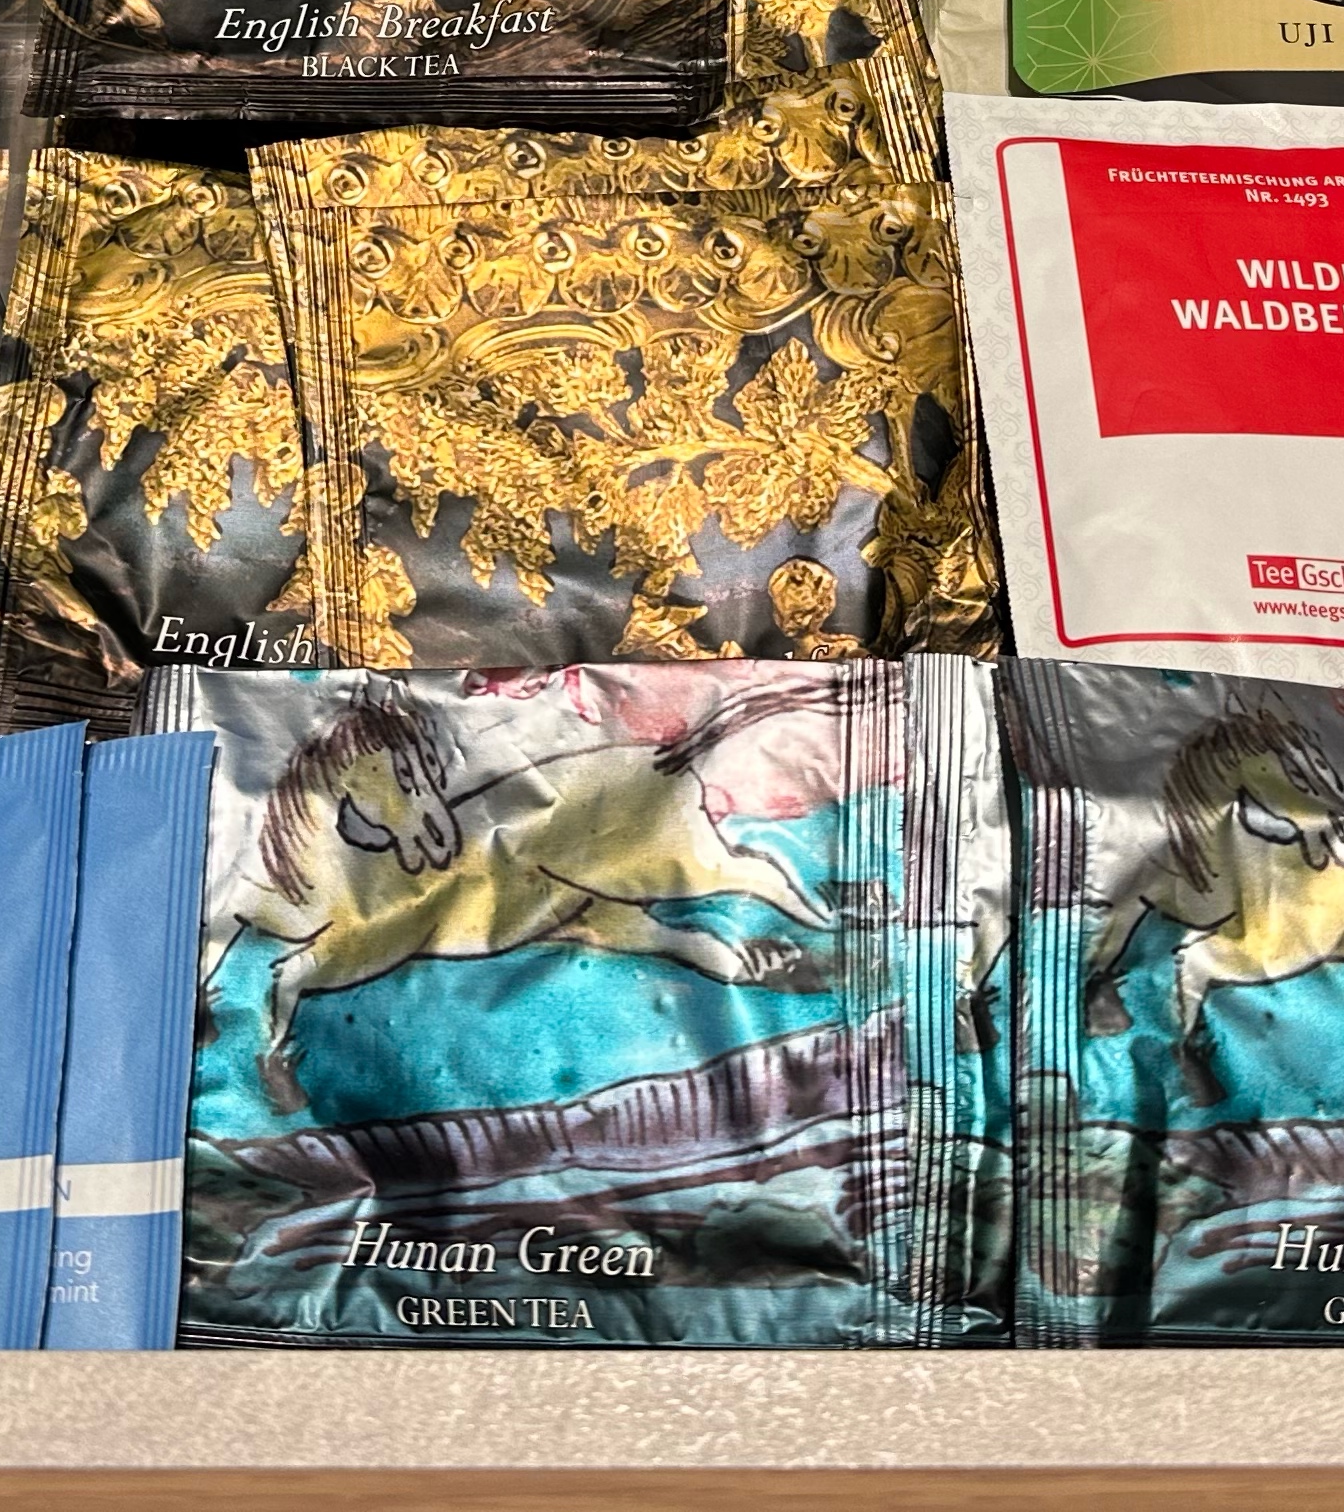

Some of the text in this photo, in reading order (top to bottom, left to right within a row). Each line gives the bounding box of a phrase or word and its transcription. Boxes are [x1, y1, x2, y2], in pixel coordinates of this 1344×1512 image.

[213, 0, 557, 53] English Breakfast
[1278, 21, 1335, 47] UJI
[301, 54, 461, 80] BLACK TEA
[1107, 166, 1319, 190] FRÜCHTETEEMISCHUNG
[1281, 190, 1330, 209] 1493
[1251, 560, 1295, 586] Tee
[152, 615, 314, 668] English
[343, 1221, 656, 1278] Hunan Green
[396, 1295, 595, 1330] GREEN TEA
